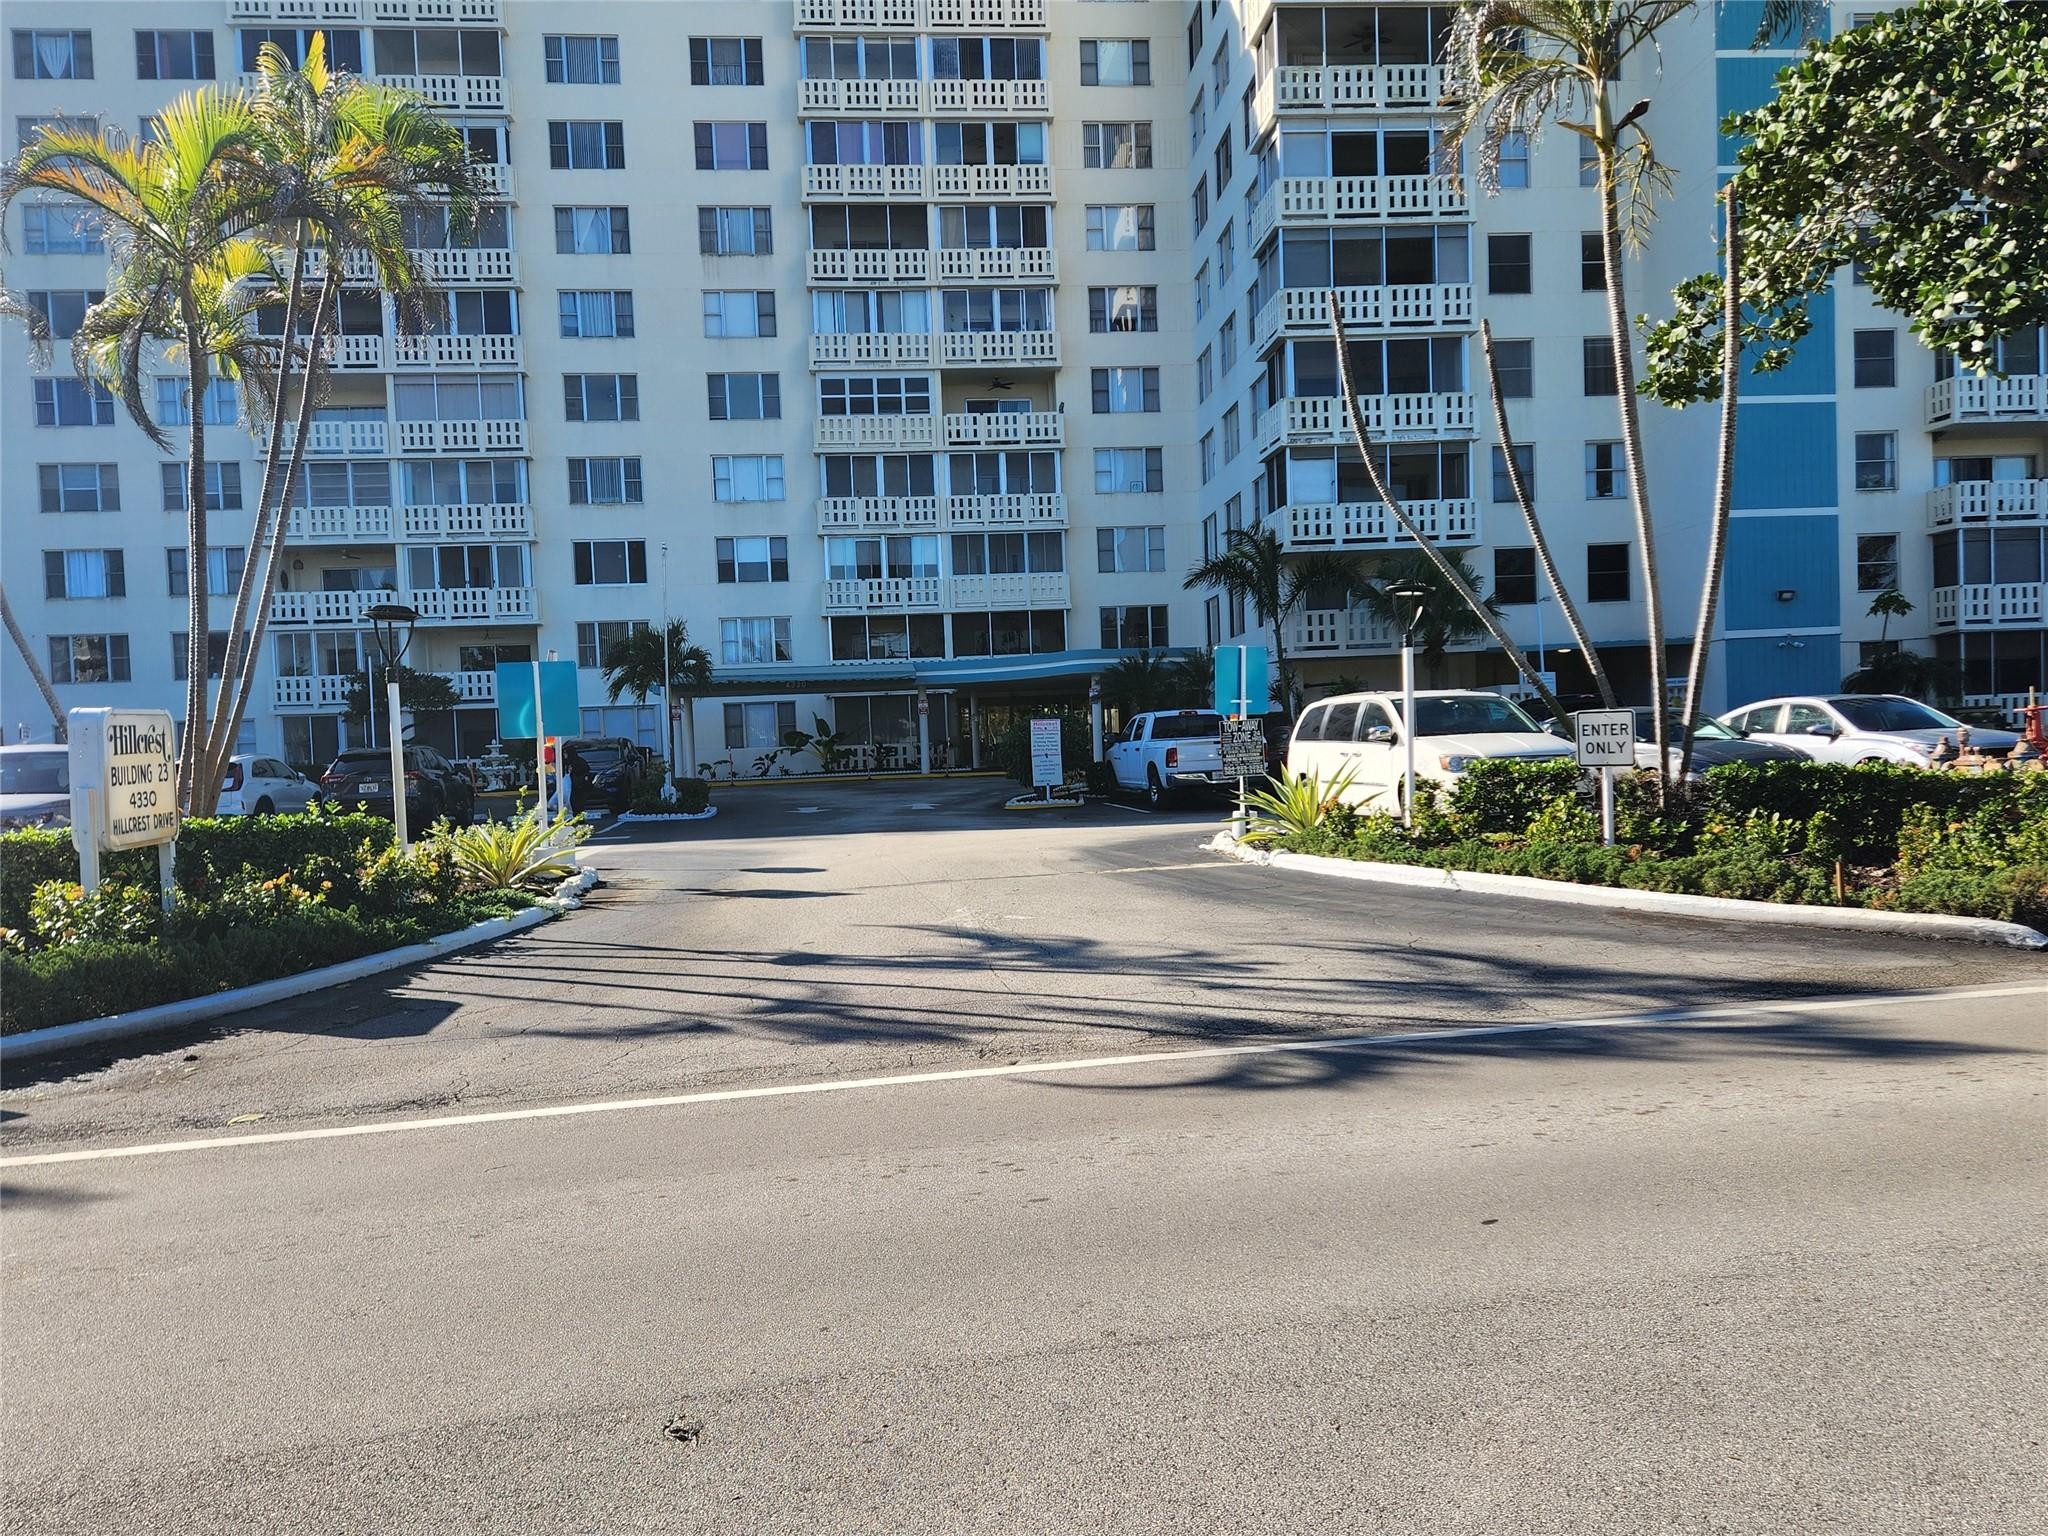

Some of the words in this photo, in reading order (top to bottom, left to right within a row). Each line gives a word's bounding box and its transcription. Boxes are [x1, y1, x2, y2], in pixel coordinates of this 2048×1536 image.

[1223, 720, 1259, 732] TOW-AWAY
[1582, 723, 1629, 736] ENTER
[107, 725, 171, 763] Hillcrest
[1232, 732, 1252, 743] ZONE
[1585, 741, 1626, 754] ONLY
[111, 764, 153, 786] BUILDING
[158, 763, 169, 782] 23
[129, 790, 157, 808] 4330
[112, 815, 150, 836] HILLCREST
[154, 812, 174, 829] DRIVE
